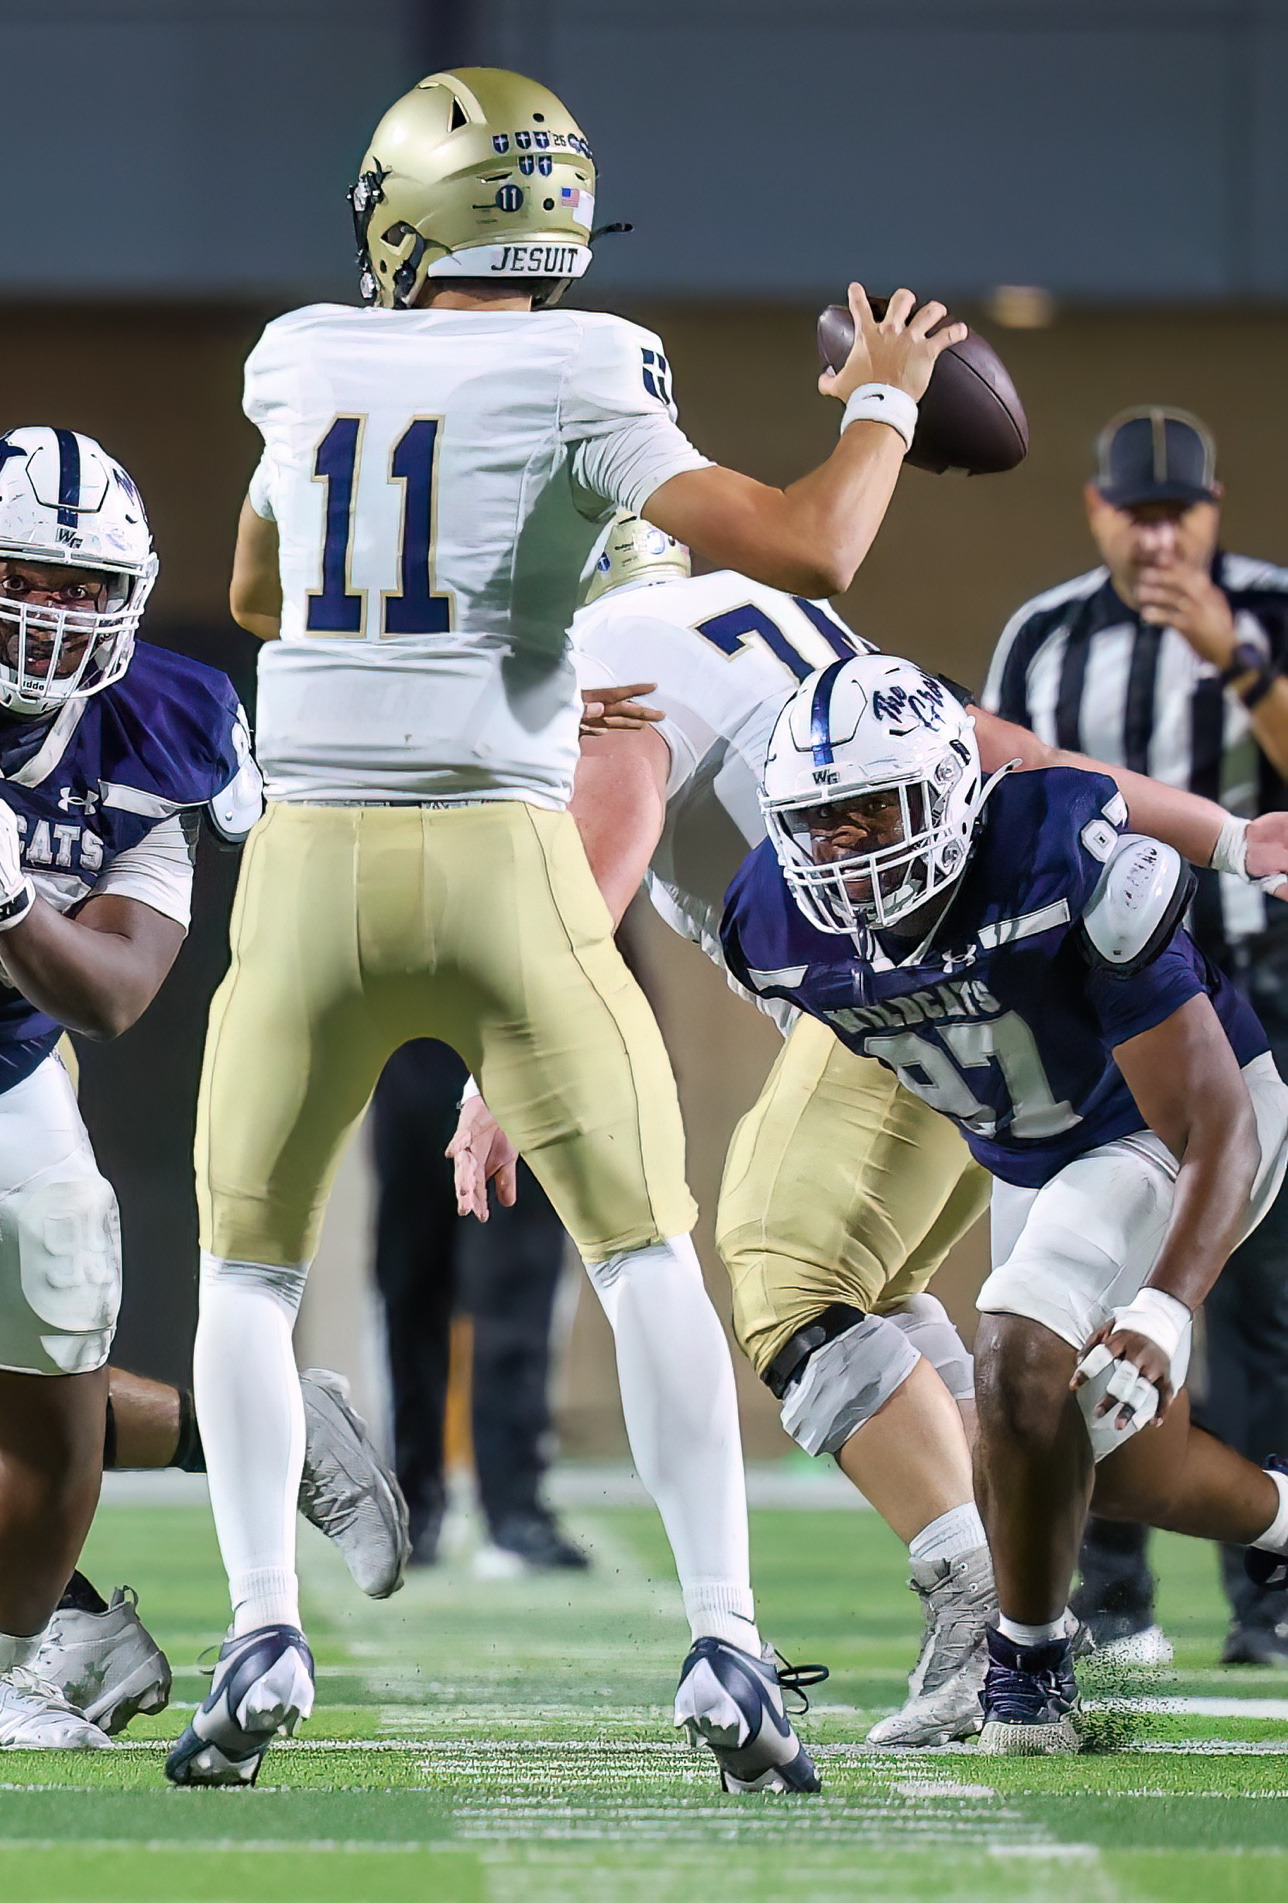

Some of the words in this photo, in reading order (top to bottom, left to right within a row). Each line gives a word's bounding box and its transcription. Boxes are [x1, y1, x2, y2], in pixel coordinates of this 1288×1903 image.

[499, 187, 518, 211] 11
[490, 246, 579, 273] JESUIT
[56, 528, 84, 549] WG
[304, 412, 457, 640] 11
[812, 769, 840, 785] WG
[864, 1009, 1084, 1140] 97
